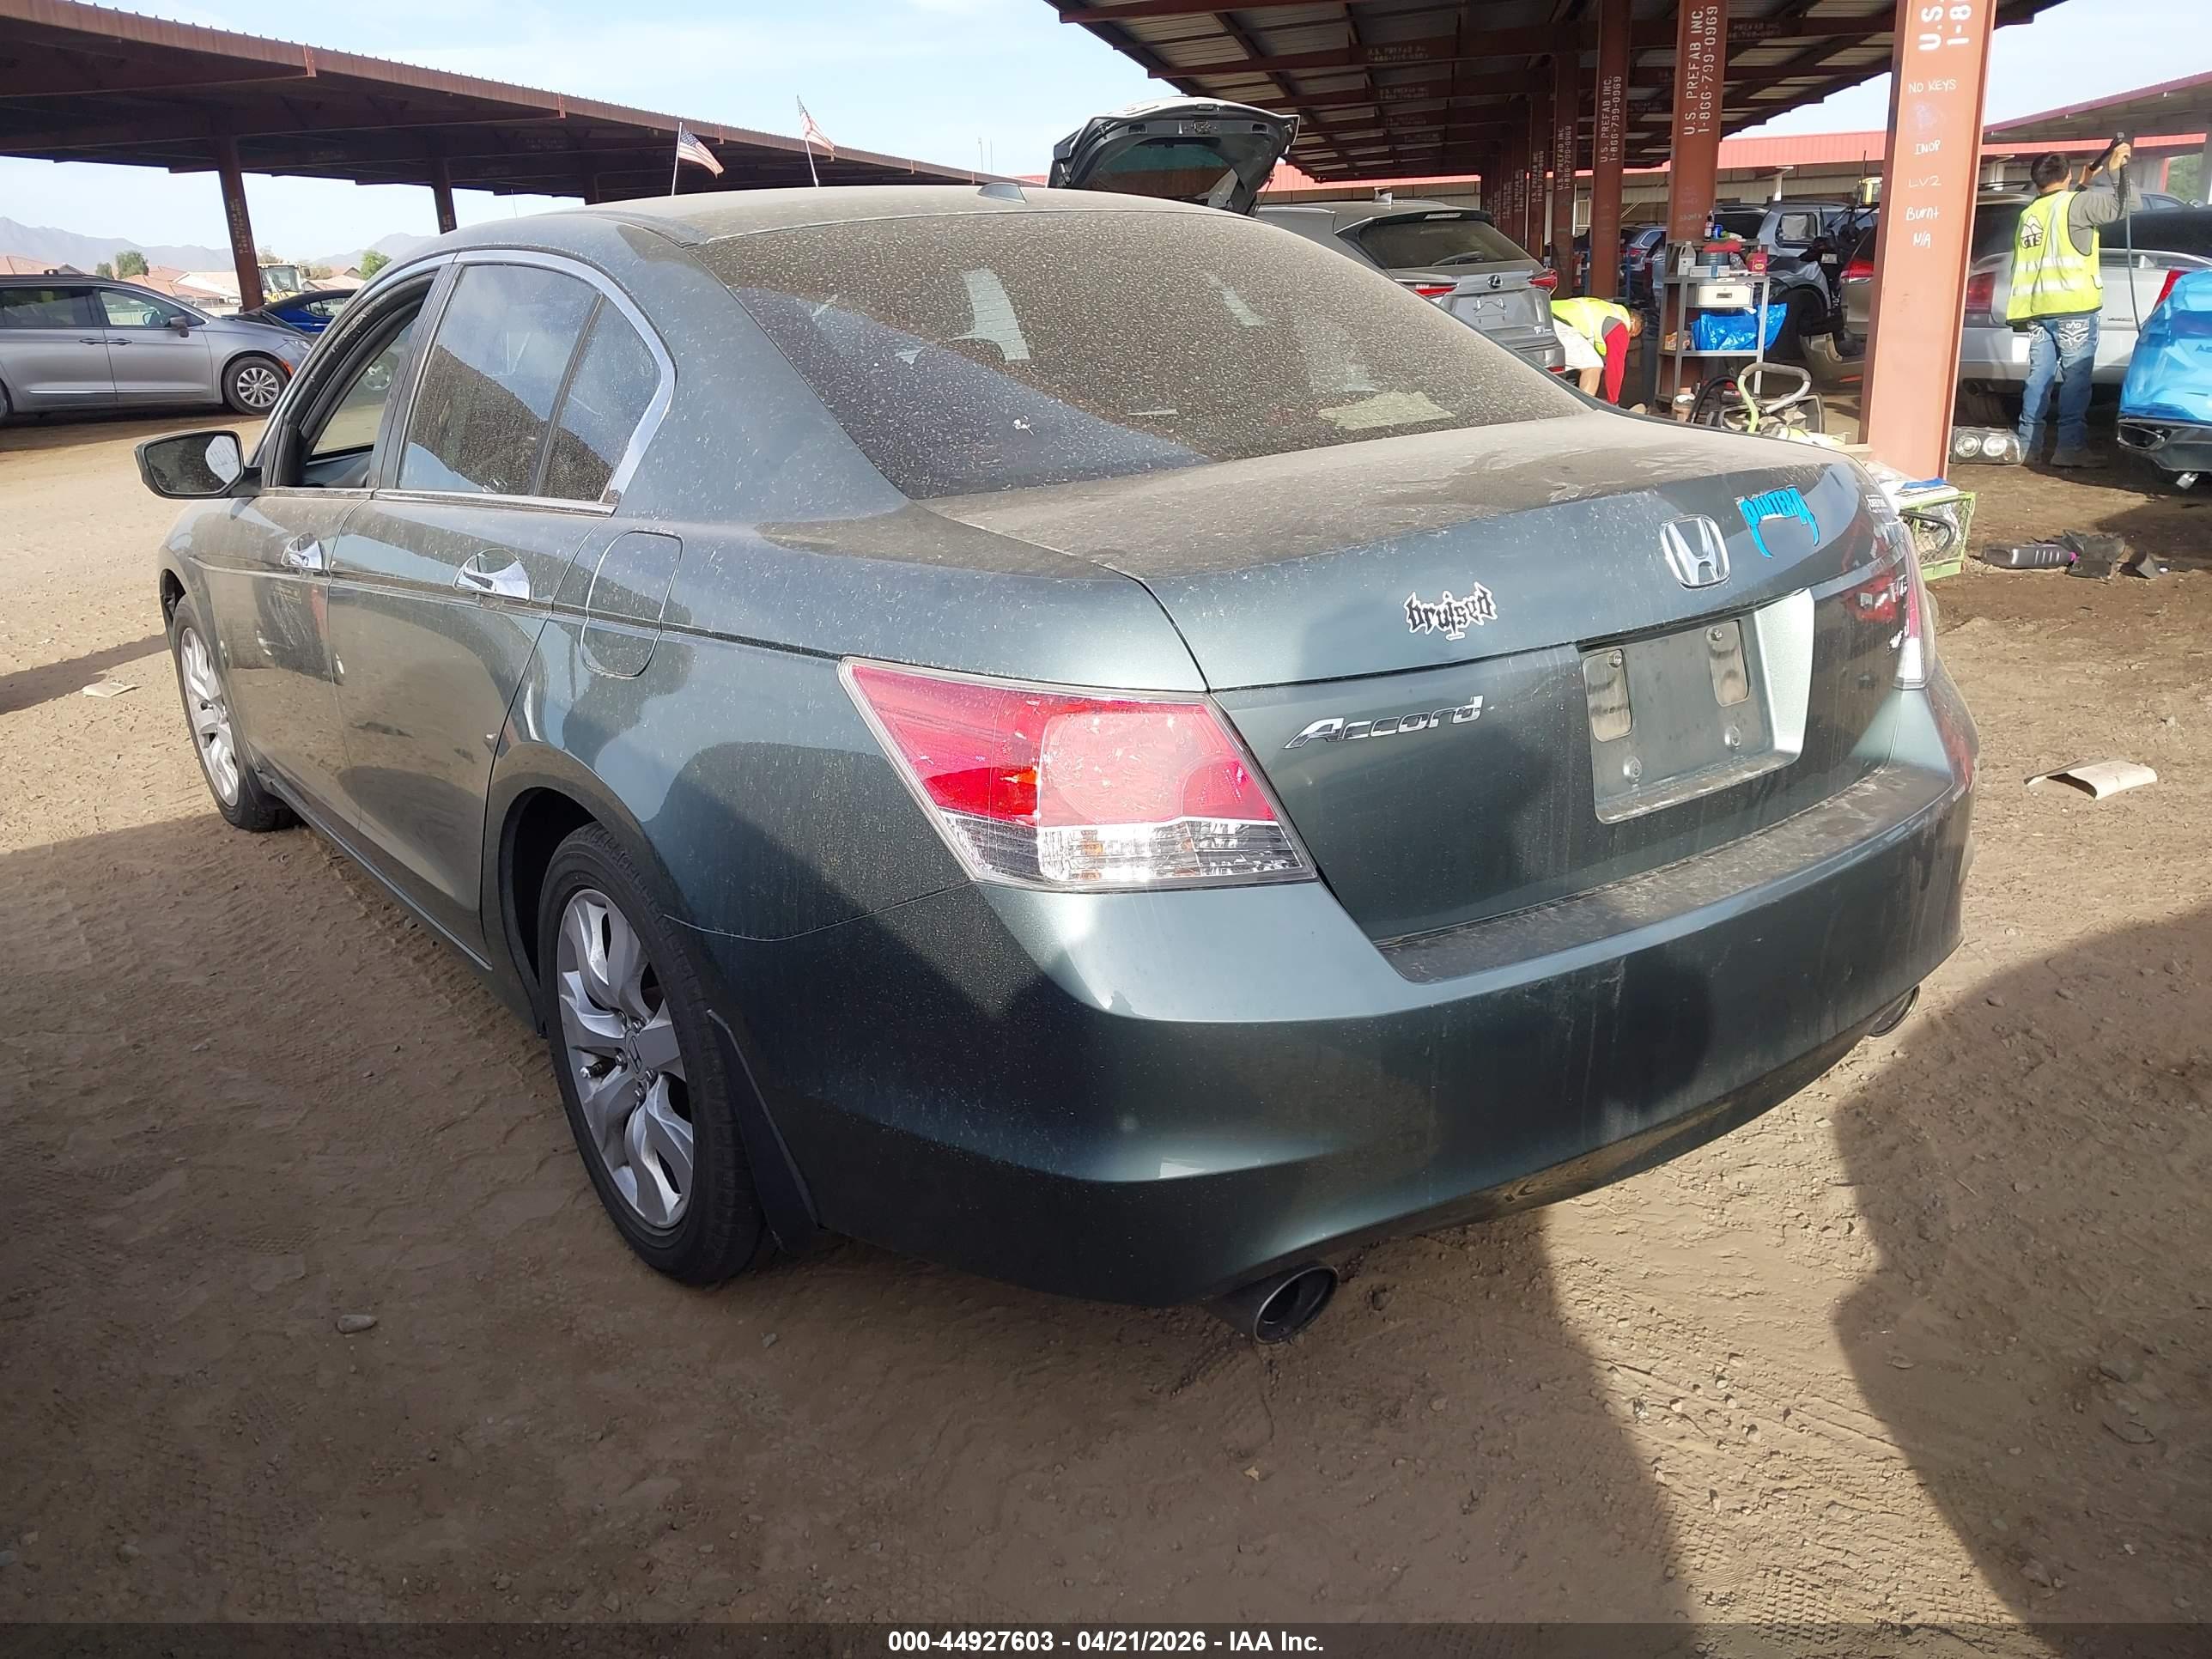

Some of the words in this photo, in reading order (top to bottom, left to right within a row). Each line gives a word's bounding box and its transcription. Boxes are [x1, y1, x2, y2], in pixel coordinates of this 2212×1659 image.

[1690, 5, 1705, 33] INC.
[1946, 0, 1972, 46] 1-8
[1686, 42, 1701, 99] PREFAB
[1698, 5, 1718, 133] 1-866-799-0969
[1908, 82, 1924, 94] NO
[1928, 78, 1957, 93] KEYS
[1601, 100, 1611, 138] PREFAB
[1683, 107, 1698, 136] U.S.
[1914, 138, 1941, 155] INOP
[1908, 175, 1942, 188] LV2
[1905, 205, 1940, 221] Burnt
[1912, 229, 1931, 249] N/A
[1404, 582, 1497, 641] bruised
[1282, 694, 1485, 750] Accord
